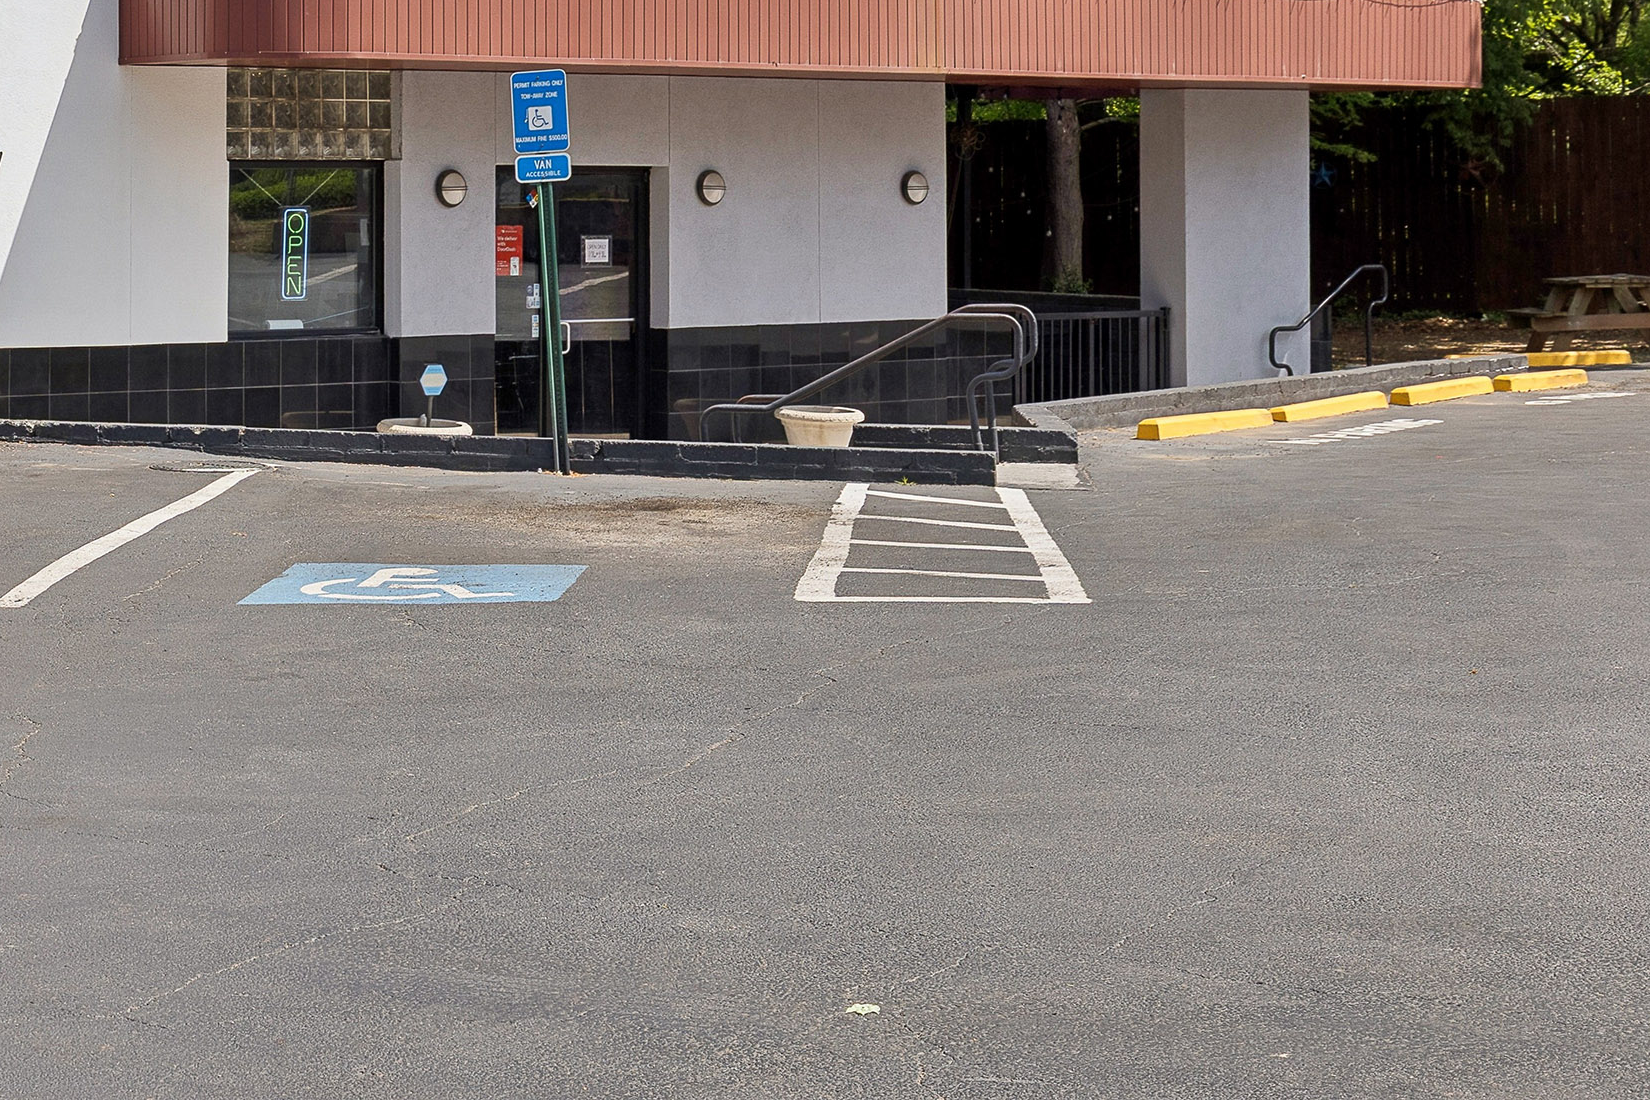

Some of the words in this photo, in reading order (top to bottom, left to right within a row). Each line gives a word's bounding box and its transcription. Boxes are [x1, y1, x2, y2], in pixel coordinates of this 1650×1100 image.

[513, 81, 530, 89] PERMIT
[534, 159, 552, 170] VAN
[526, 170, 561, 178] ACCESSIBLE
[286, 213, 304, 296] OPEN
